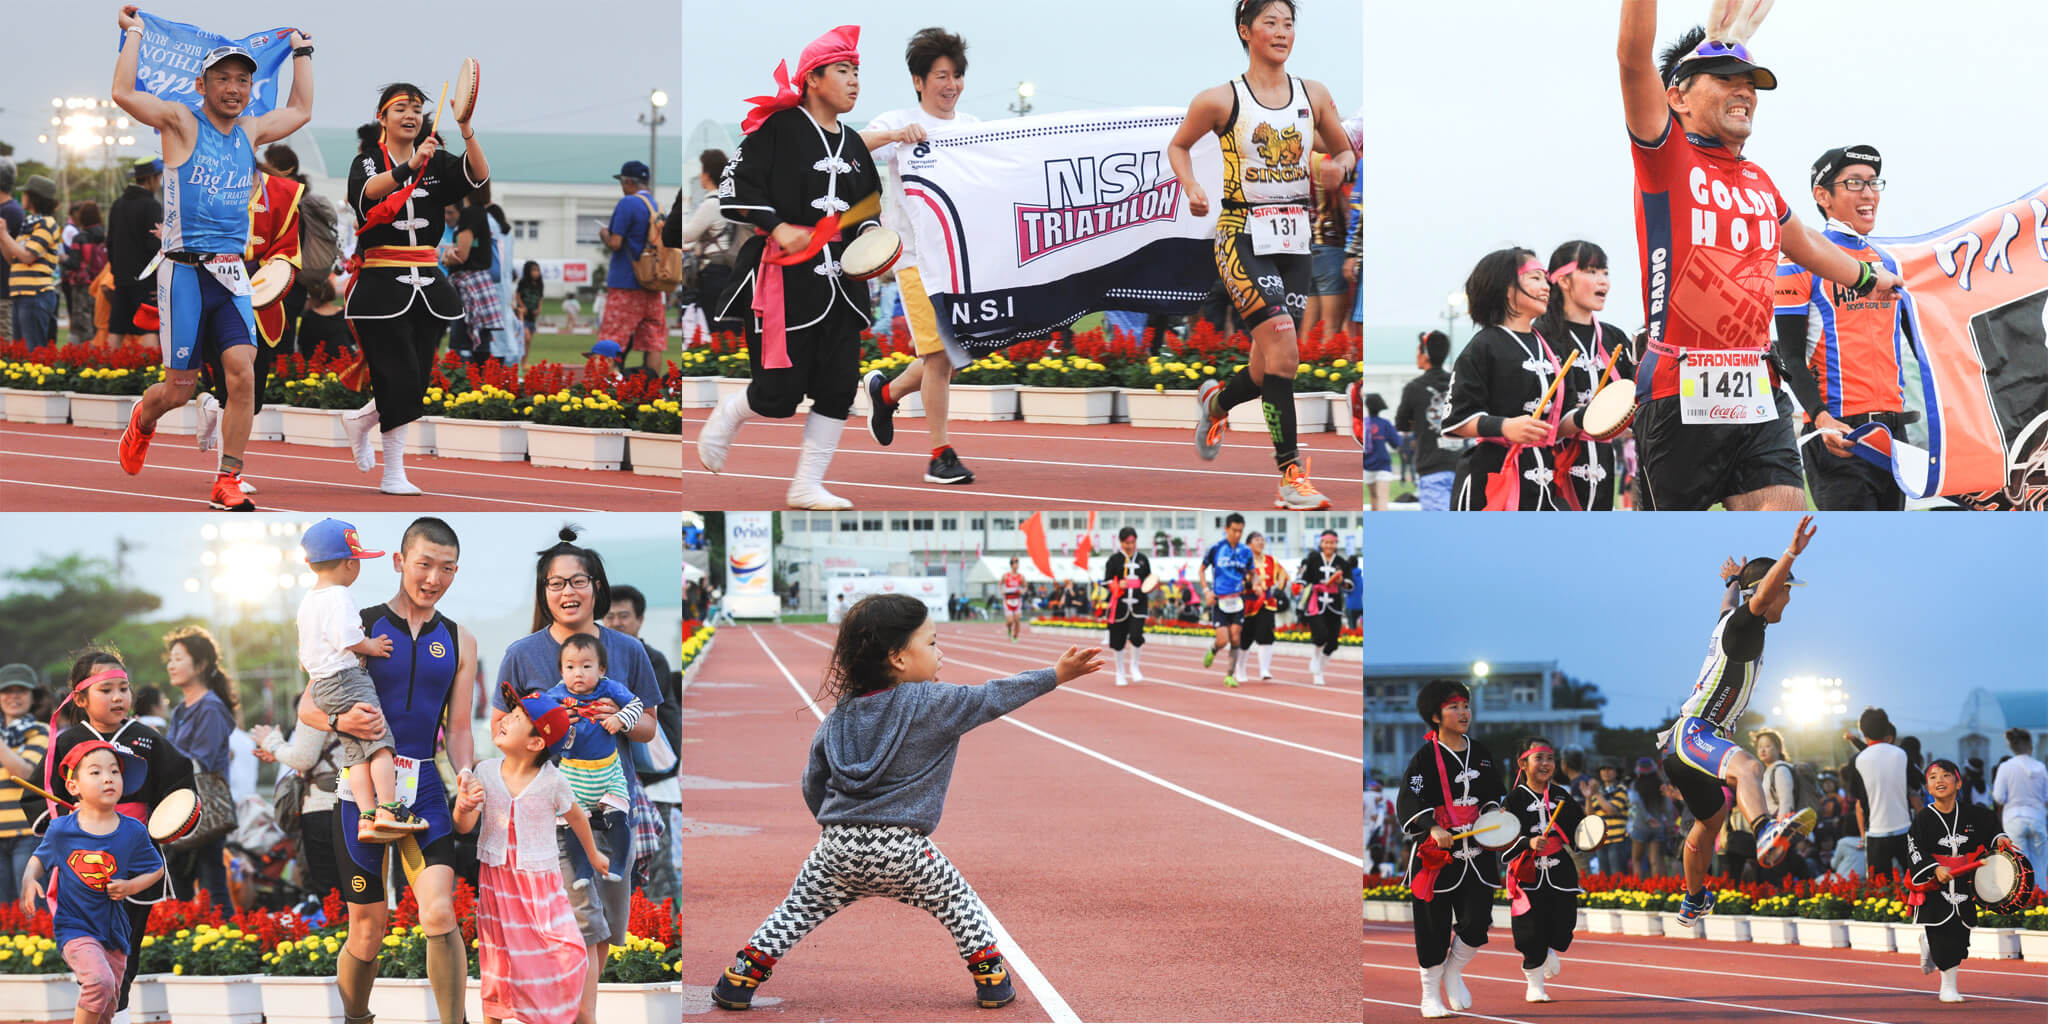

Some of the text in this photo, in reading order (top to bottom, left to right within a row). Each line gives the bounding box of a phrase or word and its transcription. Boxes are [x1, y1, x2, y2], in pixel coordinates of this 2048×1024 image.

[188, 165, 222, 195] Big
[1045, 151, 1161, 210] NSI
[1022, 180, 1178, 256] TRIATHLON
[1270, 217, 1297, 236] 131
[1651, 247, 1668, 316] RADIO
[952, 296, 1015, 326] N.S.I
[1687, 353, 1760, 367] STRONGMAN
[1699, 371, 1753, 398] 1421
[978, 961, 990, 973] 5
